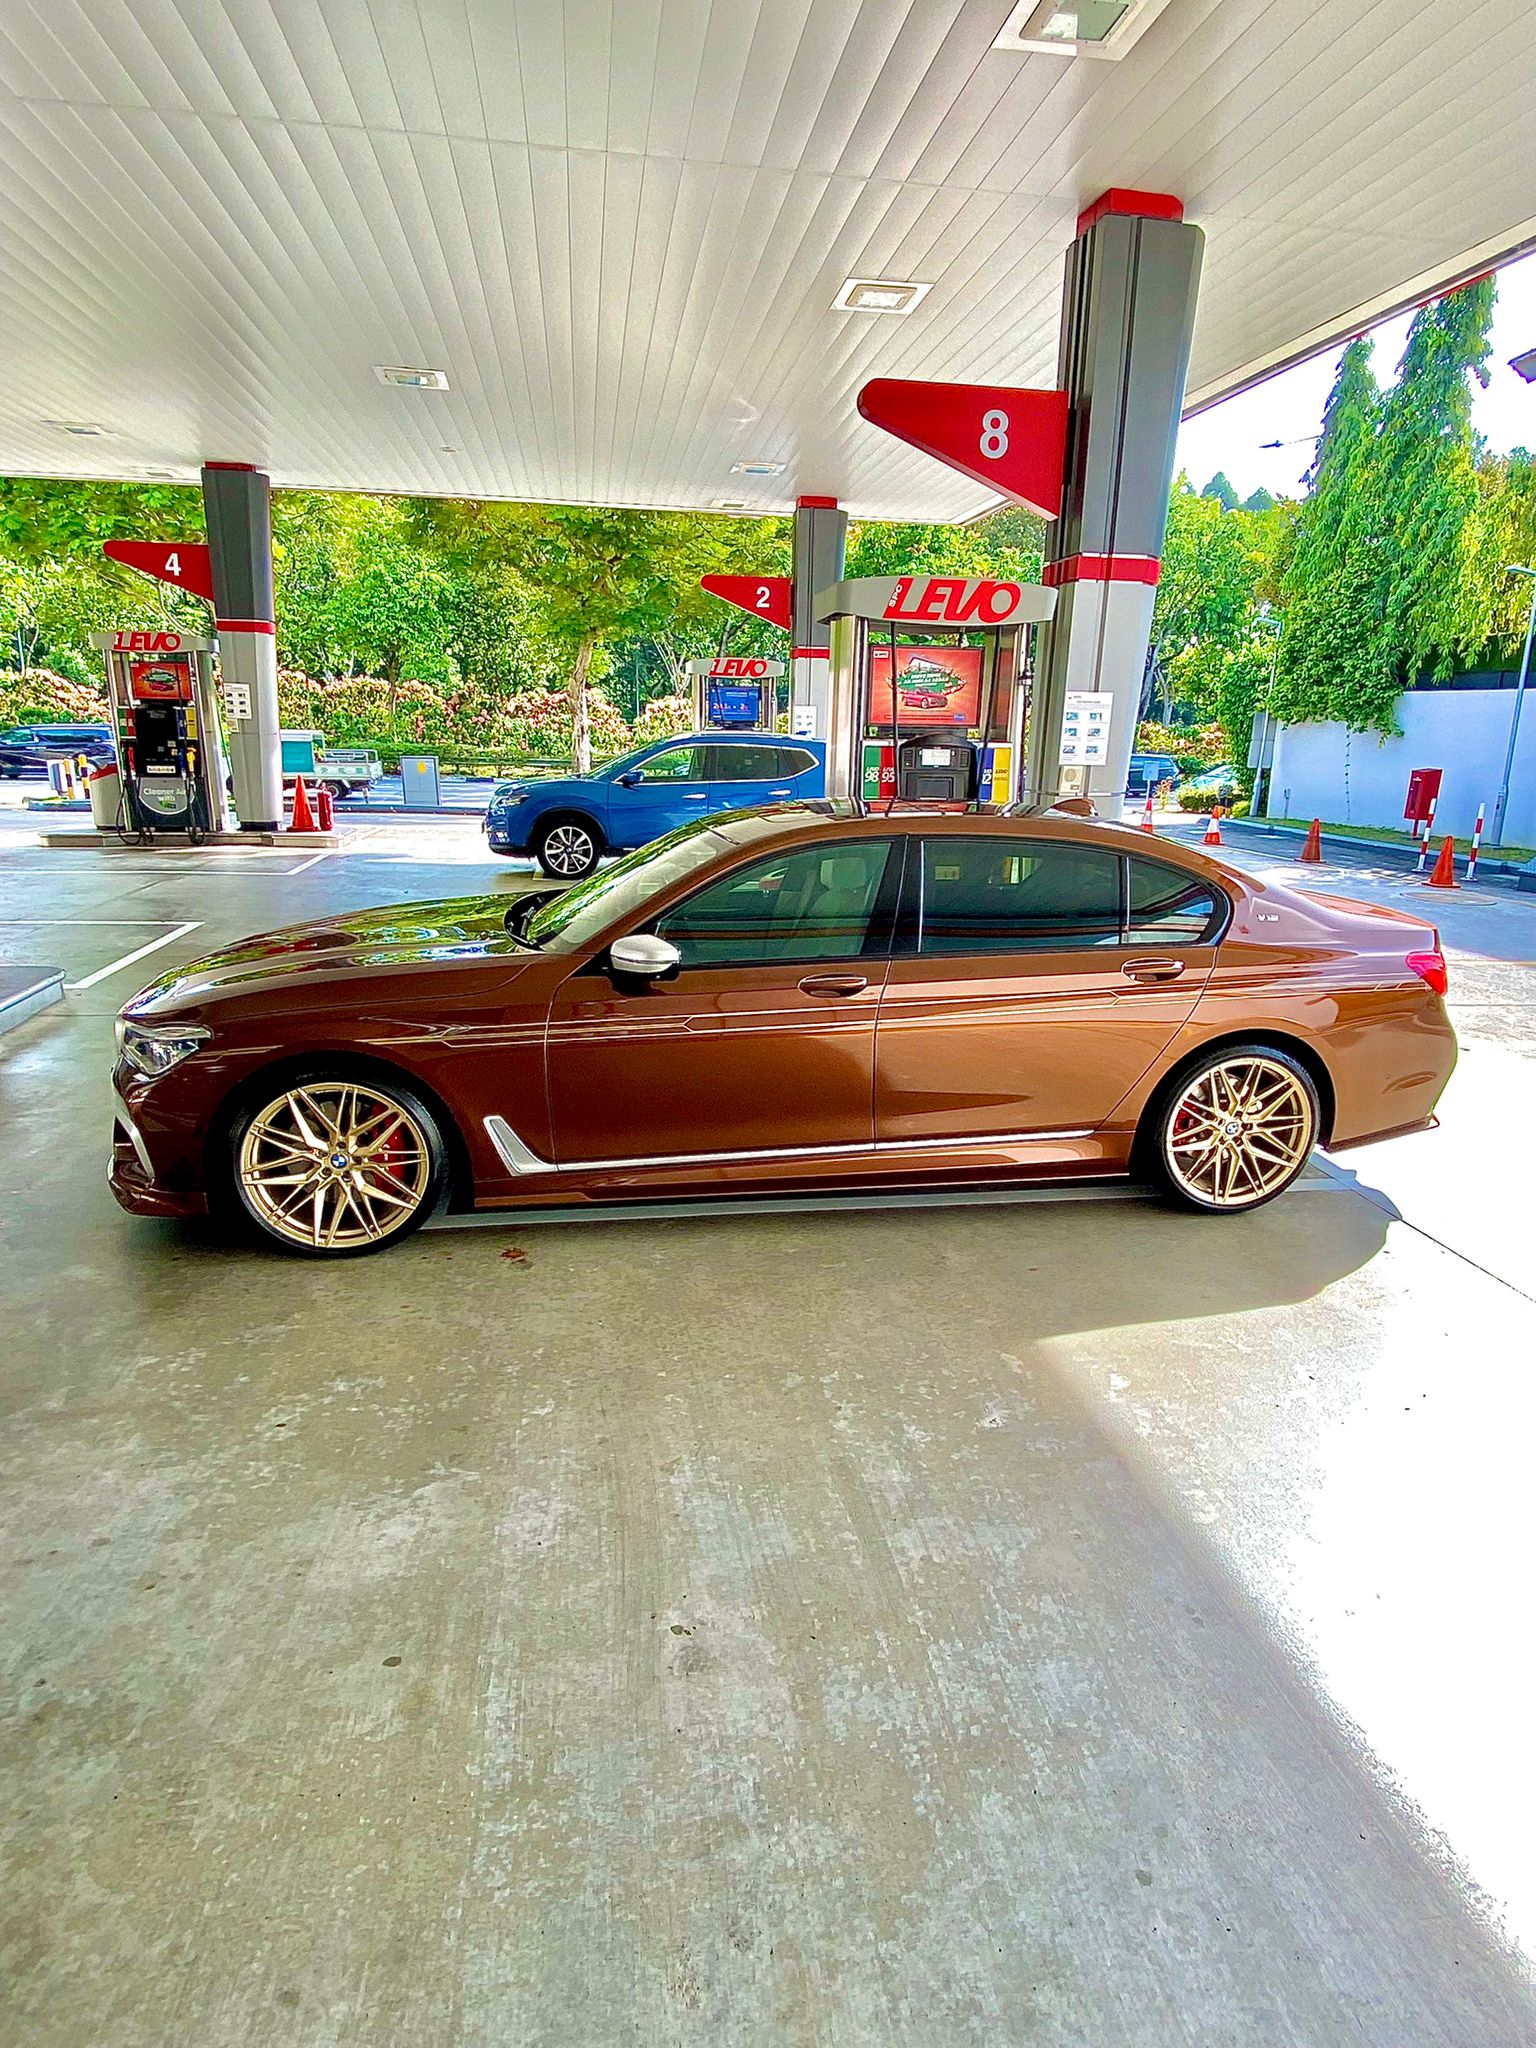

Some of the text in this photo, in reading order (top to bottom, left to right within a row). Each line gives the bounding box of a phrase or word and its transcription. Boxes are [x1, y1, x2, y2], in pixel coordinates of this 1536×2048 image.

[980, 409, 1009, 459] 8
[165, 552, 182, 577] 4
[756, 586, 771, 608] 2
[882, 577, 1022, 624] LEVO
[888, 583, 904, 608] SPC
[113, 631, 182, 652] LEVO
[708, 658, 768, 677] LEVO
[864, 771, 880, 783] 98
[881, 771, 896, 783] 95
[143, 787, 187, 796] Cleaner Ai
